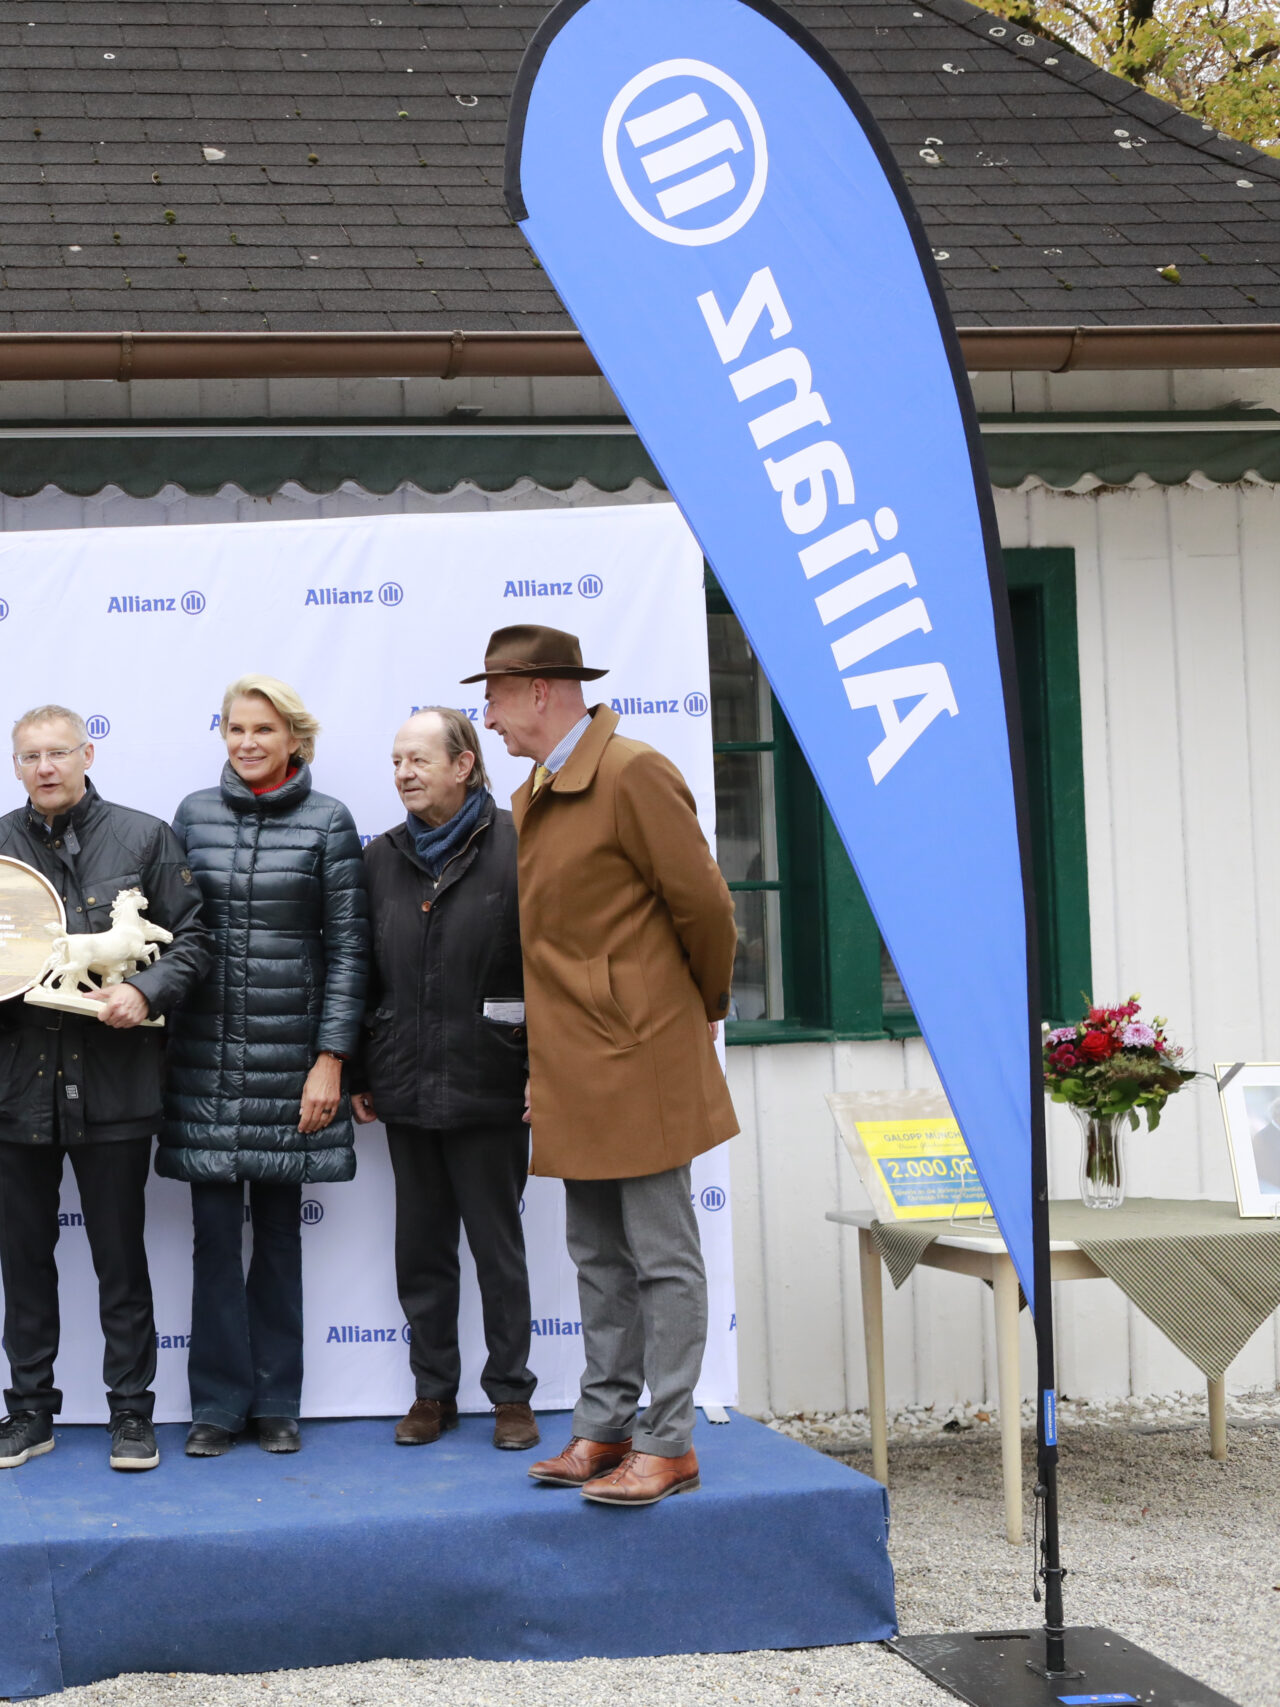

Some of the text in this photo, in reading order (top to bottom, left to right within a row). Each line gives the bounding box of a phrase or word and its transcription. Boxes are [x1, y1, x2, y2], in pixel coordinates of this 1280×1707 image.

[305, 588, 374, 606] Allianz
[504, 580, 574, 598] Allianz
[108, 595, 177, 614] Allianz
[611, 698, 681, 717] Allianz
[884, 1129, 963, 1143] GALOPP MÜNCH
[326, 1325, 398, 1344] Allianz
[531, 1317, 583, 1337] Allian
